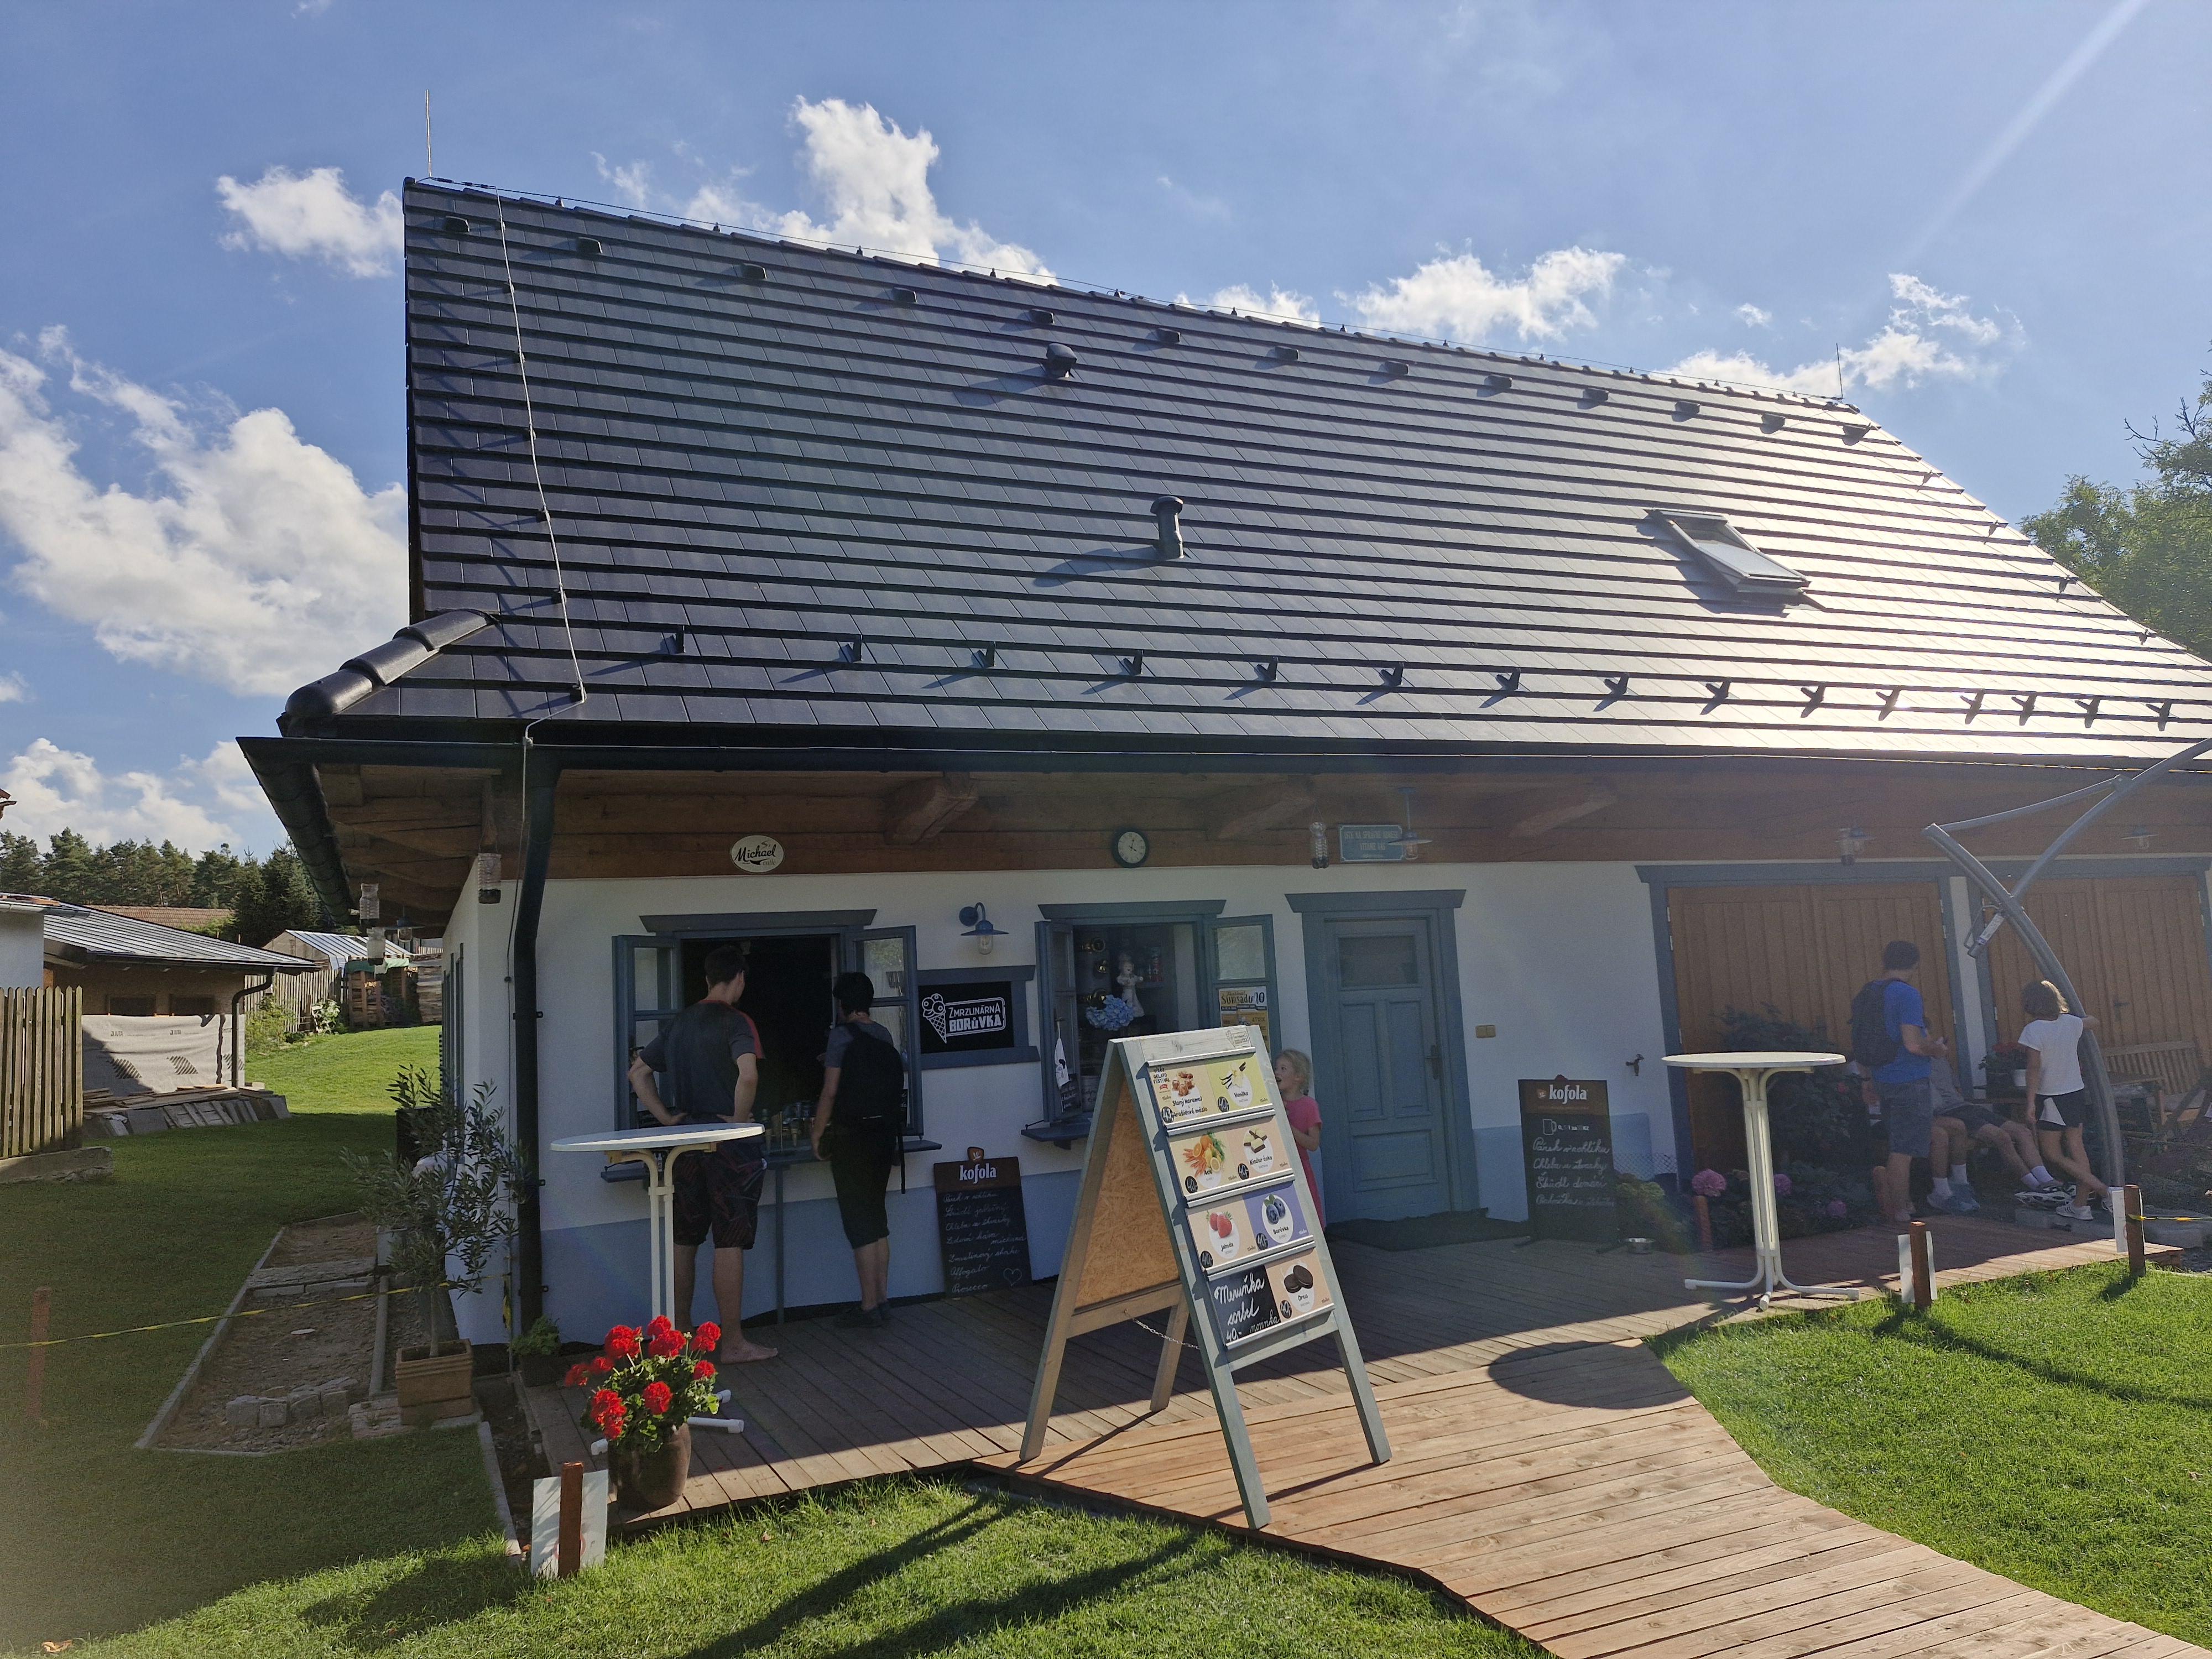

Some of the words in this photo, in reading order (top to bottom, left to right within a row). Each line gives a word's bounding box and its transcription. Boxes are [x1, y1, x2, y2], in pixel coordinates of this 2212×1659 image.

[735, 844, 776, 862] Michael
[1254, 992, 1265, 1004] 10
[948, 1002, 1001, 1018] ZMRZLINÁRNA
[1549, 1084, 1587, 1104] kofola
[1172, 1098, 1185, 1107] Slaný
[1532, 1137, 1563, 1152] Párek
[959, 1163, 997, 1184] kofola
[1273, 1226, 1289, 1234] Borůvka
[1221, 1242, 1234, 1252] Jahoda
[951, 1264, 990, 1279] Affogato
[952, 1283, 989, 1293] Prosecco
[1214, 1272, 1265, 1305] Meruňka
[1227, 1297, 1260, 1326] sorbet
[1250, 1309, 1280, 1333] novinka
[1226, 1328, 1242, 1342] 40,-
